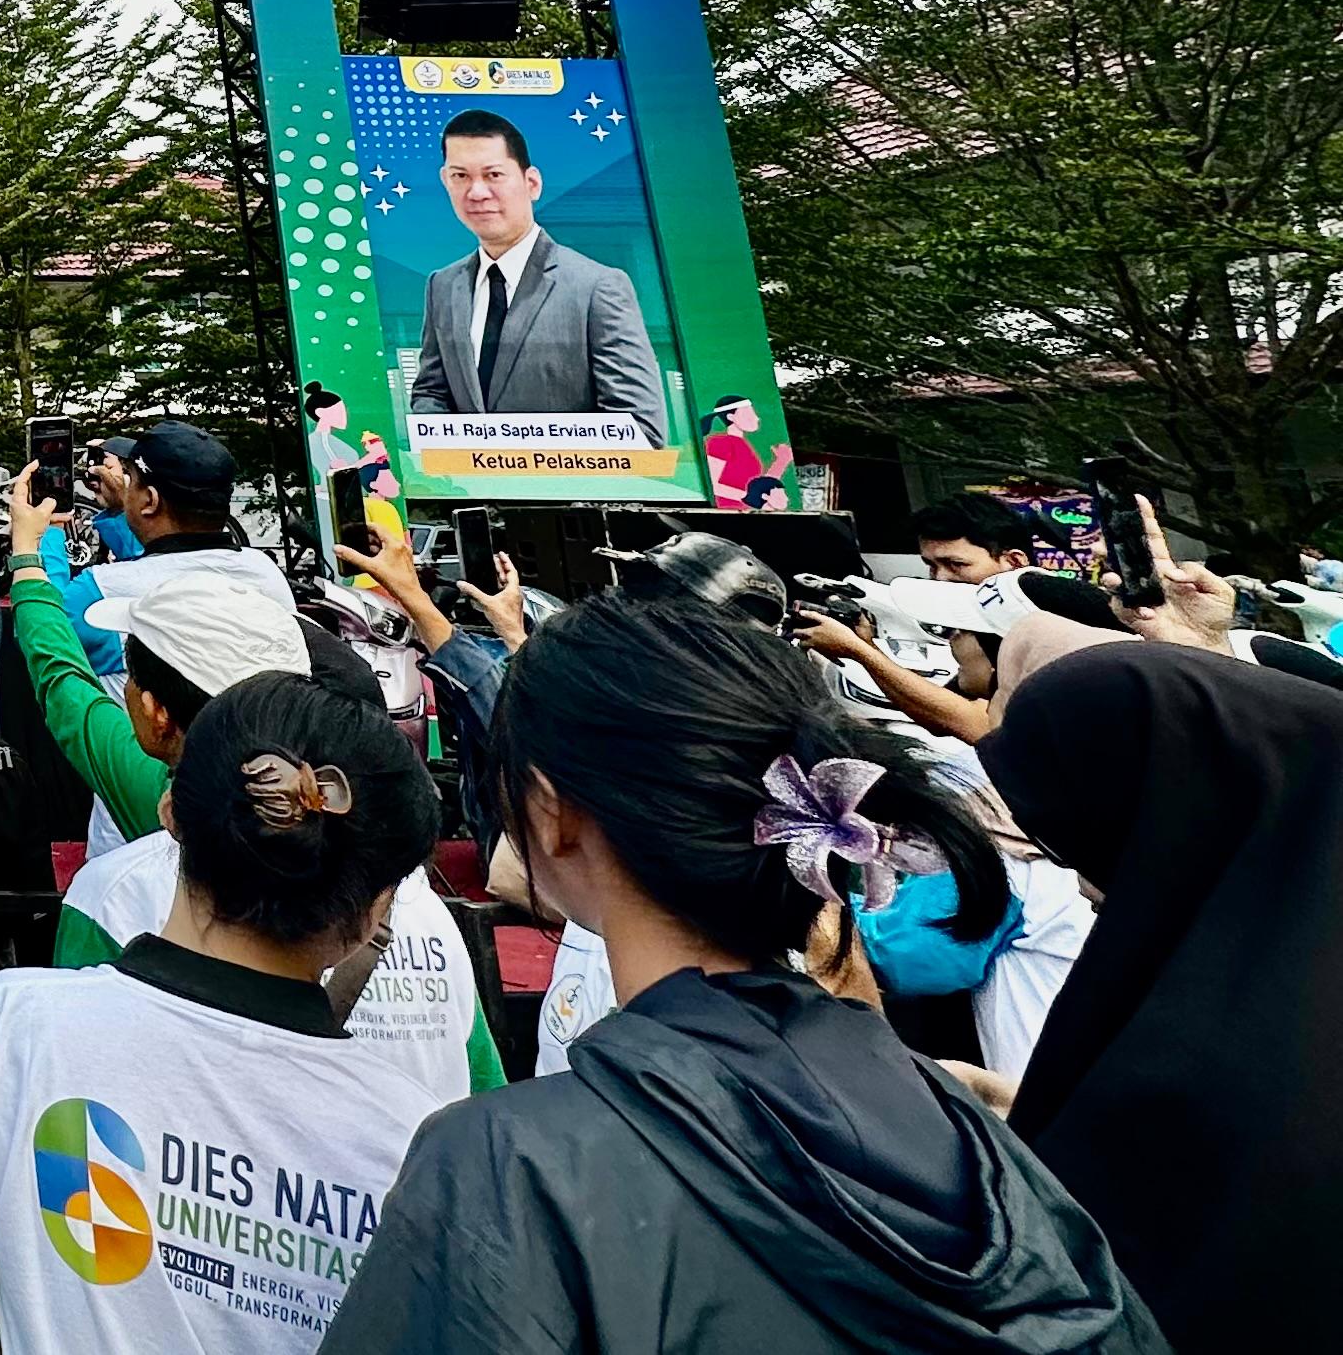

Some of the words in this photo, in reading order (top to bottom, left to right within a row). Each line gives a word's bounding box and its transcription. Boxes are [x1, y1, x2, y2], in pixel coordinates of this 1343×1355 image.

[417, 423, 439, 437] Dr.
[443, 423, 460, 437] H.
[464, 423, 497, 440] Raja
[501, 423, 545, 440] Sapta
[549, 424, 597, 438] Ervian
[601, 424, 636, 440] (Eyi)
[472, 453, 528, 469] Ketua
[534, 453, 632, 470] Pelaksana
[161, 1131, 255, 1208] DIES
[274, 1166, 380, 1244] NATA
[160, 1245, 230, 1282] EVOLUTIF
